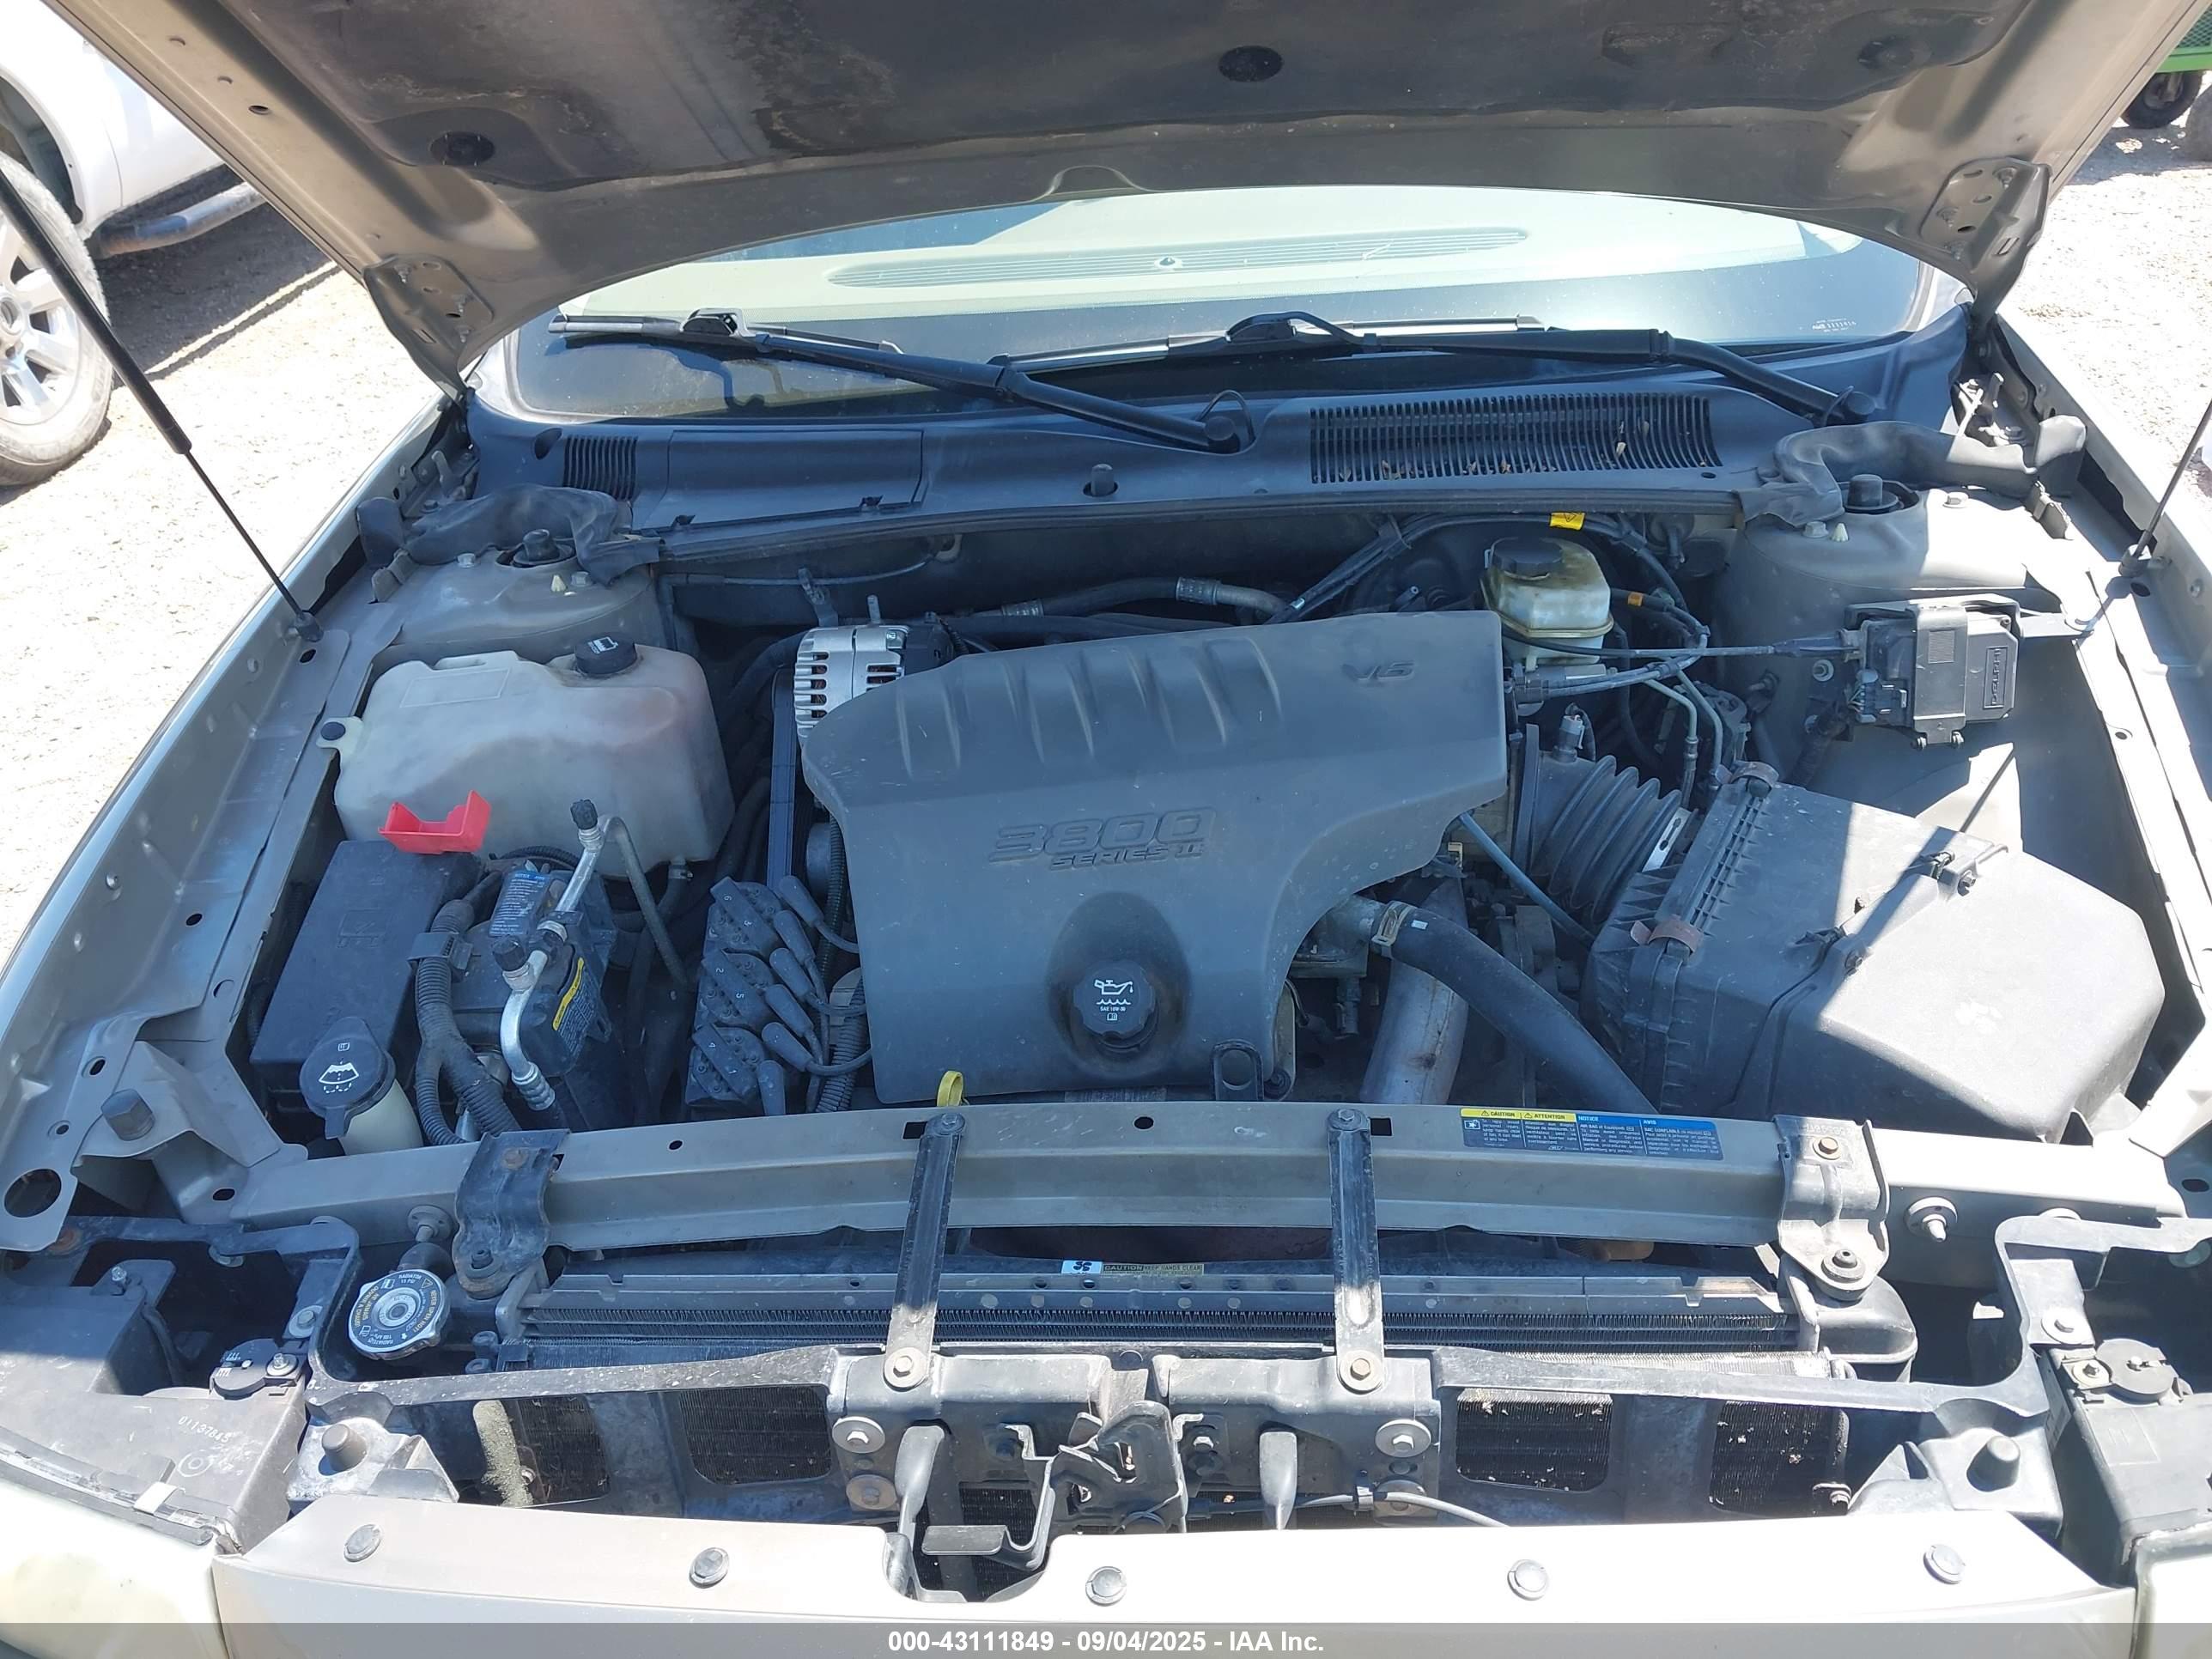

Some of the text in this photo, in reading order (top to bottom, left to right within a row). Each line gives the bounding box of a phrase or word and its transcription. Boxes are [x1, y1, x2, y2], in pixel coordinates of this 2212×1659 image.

[1342, 660, 1414, 681] V6
[1991, 647, 2002, 706] DELPHI
[988, 806, 1216, 863] 3800
[1049, 845, 1169, 871] SERIES
